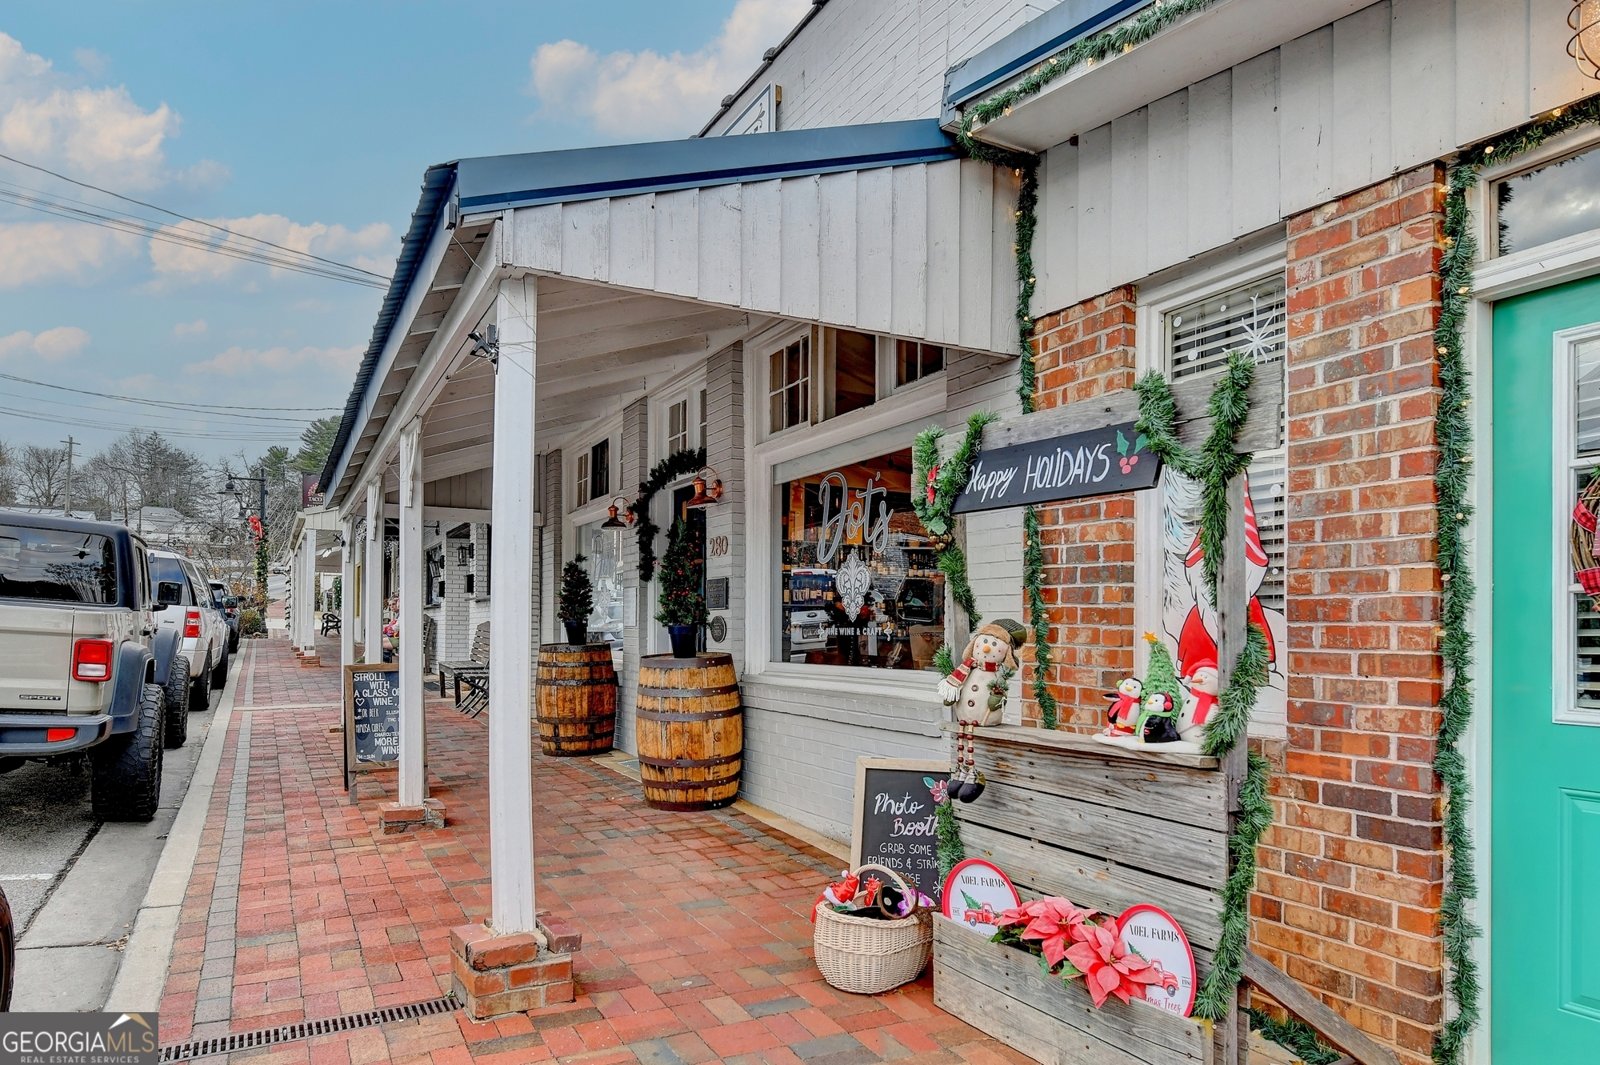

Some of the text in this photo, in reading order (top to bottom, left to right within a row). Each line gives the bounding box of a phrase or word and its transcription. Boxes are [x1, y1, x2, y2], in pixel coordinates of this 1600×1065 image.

[965, 461, 1018, 503] Happy
[817, 471, 893, 564] Dot's
[710, 535, 729, 557] 280
[839, 627, 854, 636] WINE
[862, 627, 882, 636] CRAFT
[354, 672, 385, 682] STROLL
[369, 681, 390, 690] WITH
[354, 690, 360, 698] A
[362, 688, 389, 698] GLASS
[374, 737, 399, 747] MORE
[381, 746, 400, 755] WINE
[874, 792, 924, 815] Photo
[880, 842, 932, 856] GRAB SOME
[868, 855, 904, 869] FRIENDS
[906, 858, 912, 870] &
[960, 874, 1006, 888] NOEL FARMS
[1130, 924, 1180, 942] NOEL FARMS
[1164, 997, 1181, 1014] Trees
